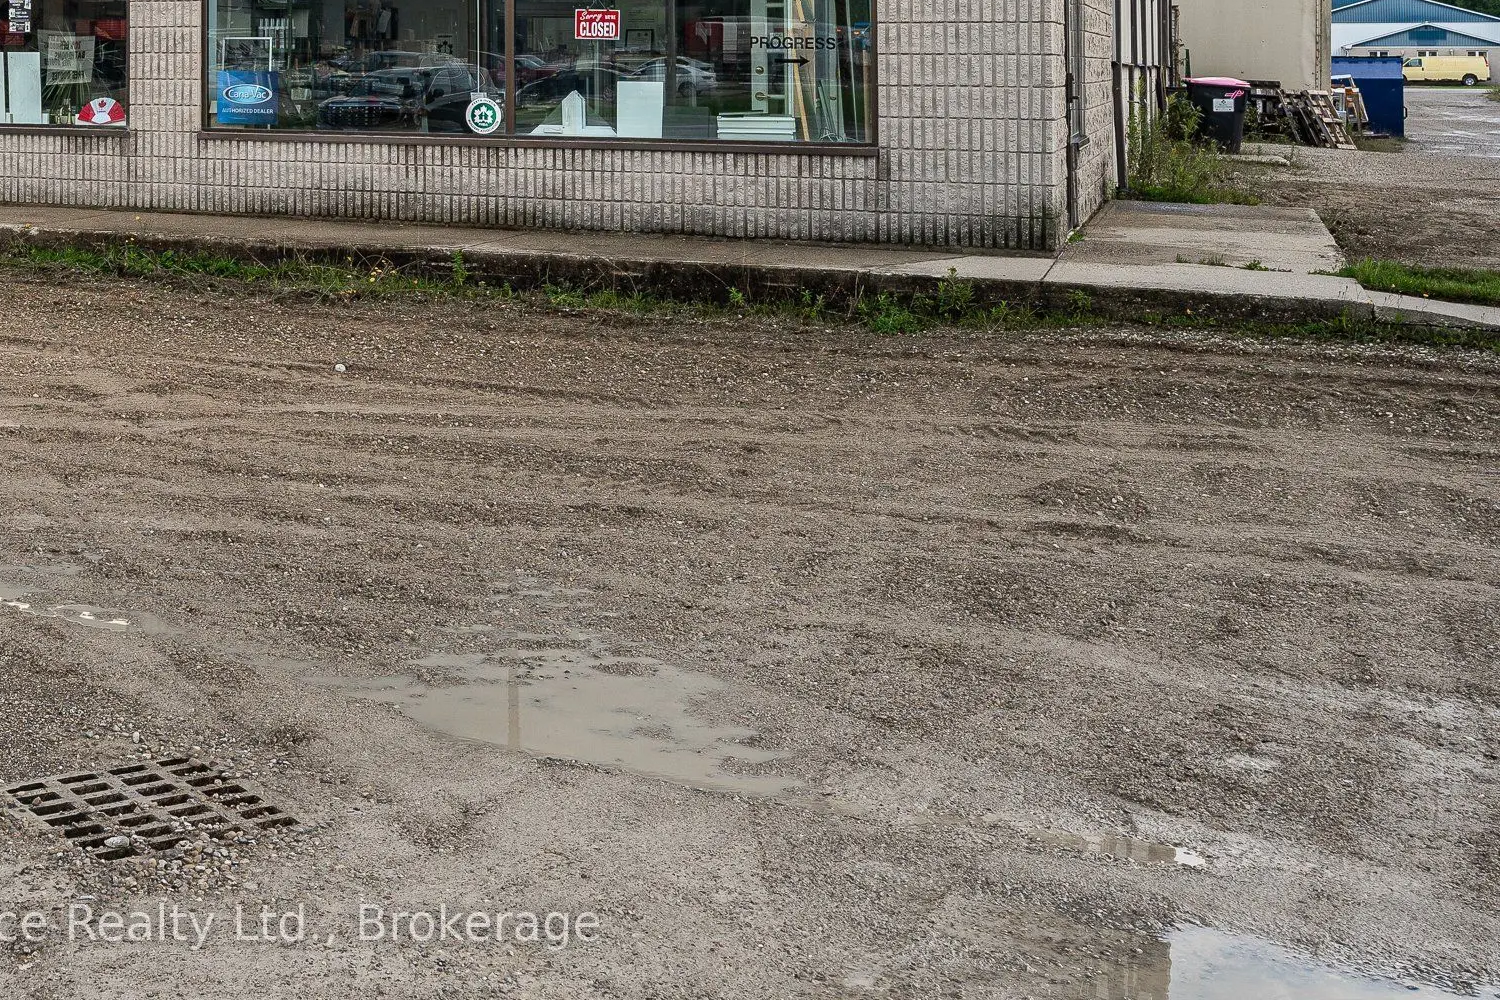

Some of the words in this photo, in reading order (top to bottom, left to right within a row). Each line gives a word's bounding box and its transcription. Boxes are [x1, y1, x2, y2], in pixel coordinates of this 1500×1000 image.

[580, 11, 602, 22] Sorry
[580, 21, 616, 37] CLOSED
[750, 36, 837, 49] PROGRESS
